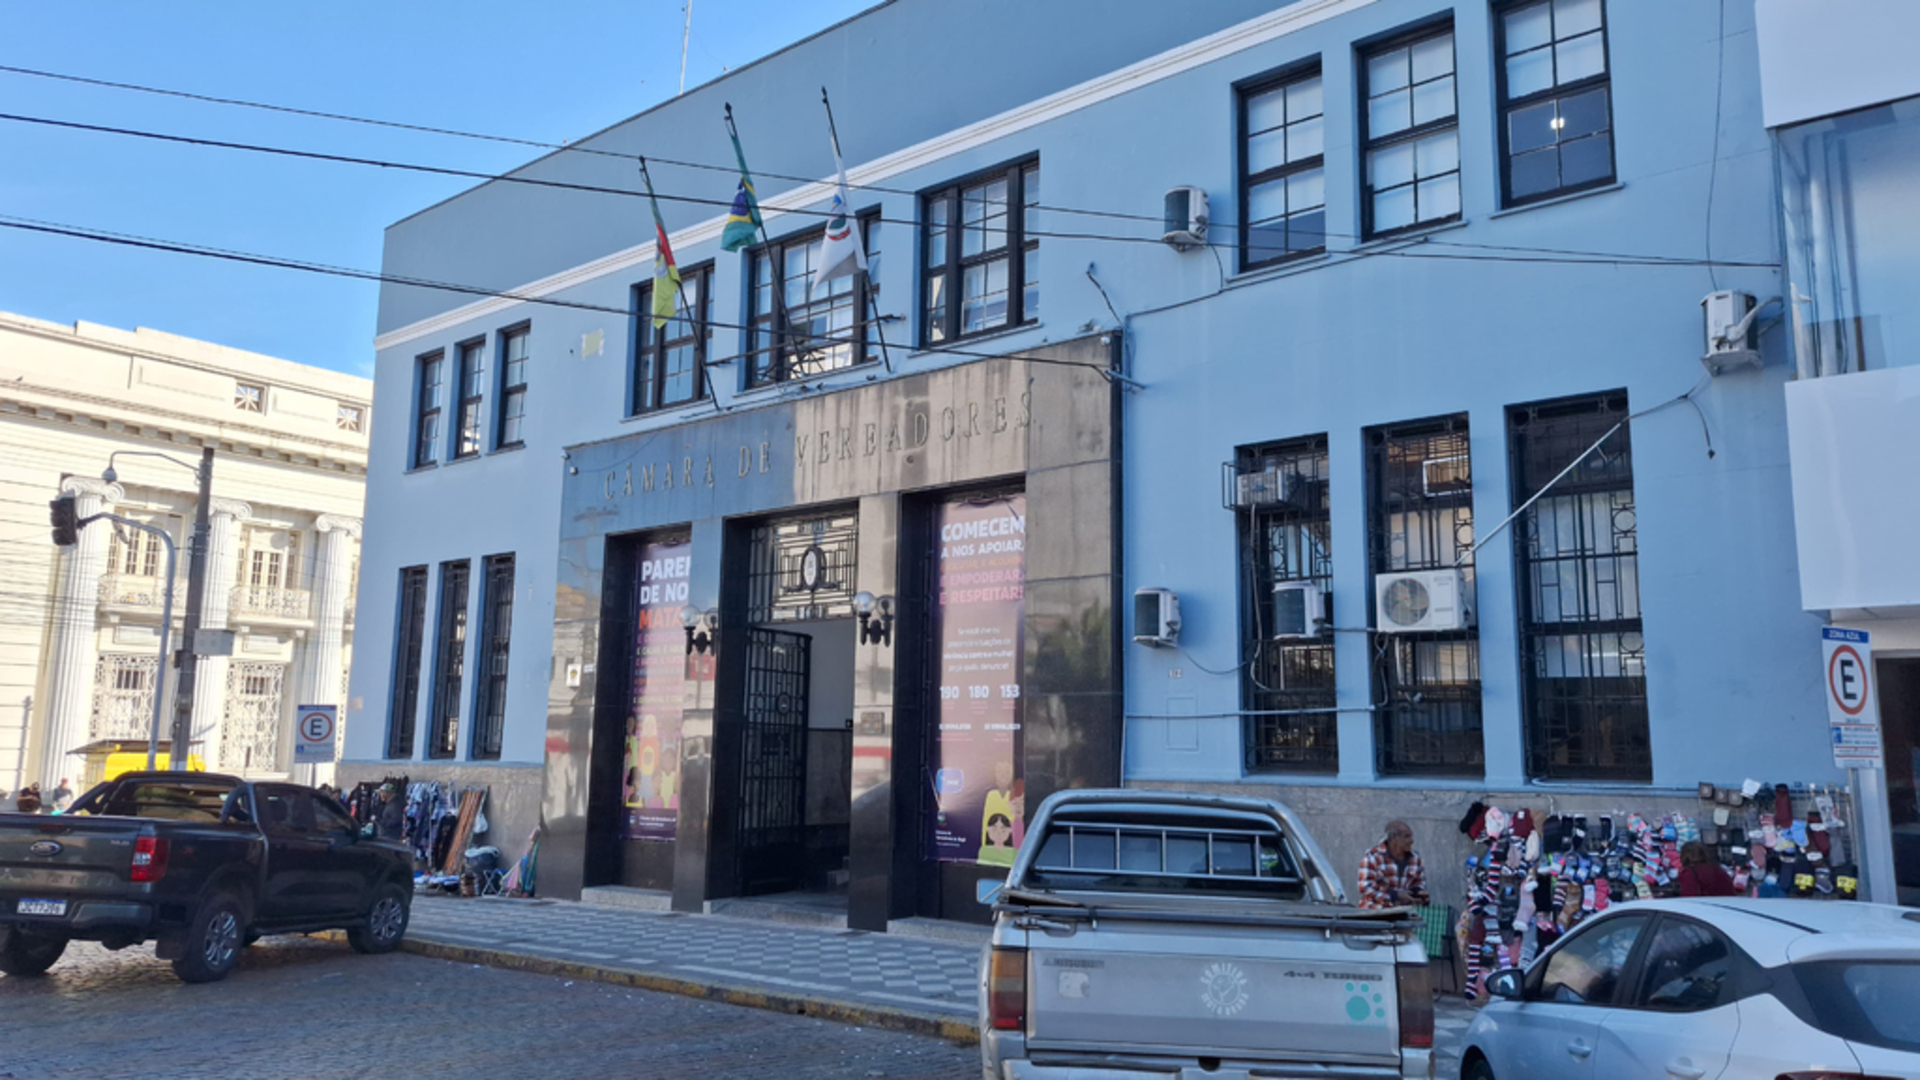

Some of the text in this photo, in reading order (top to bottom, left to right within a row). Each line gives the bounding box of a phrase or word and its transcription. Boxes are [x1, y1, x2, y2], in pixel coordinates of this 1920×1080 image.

[738, 442, 771, 478] DE
[796, 391, 1033, 468] VEREADORES
[941, 515, 1025, 542] COMECEM
[941, 547, 949, 560] A
[952, 544, 975, 557] NOS
[640, 585, 659, 604] DE
[1840, 659, 1857, 700] E
[939, 684, 1020, 699] 190 180 153
[310, 718, 323, 736] E
